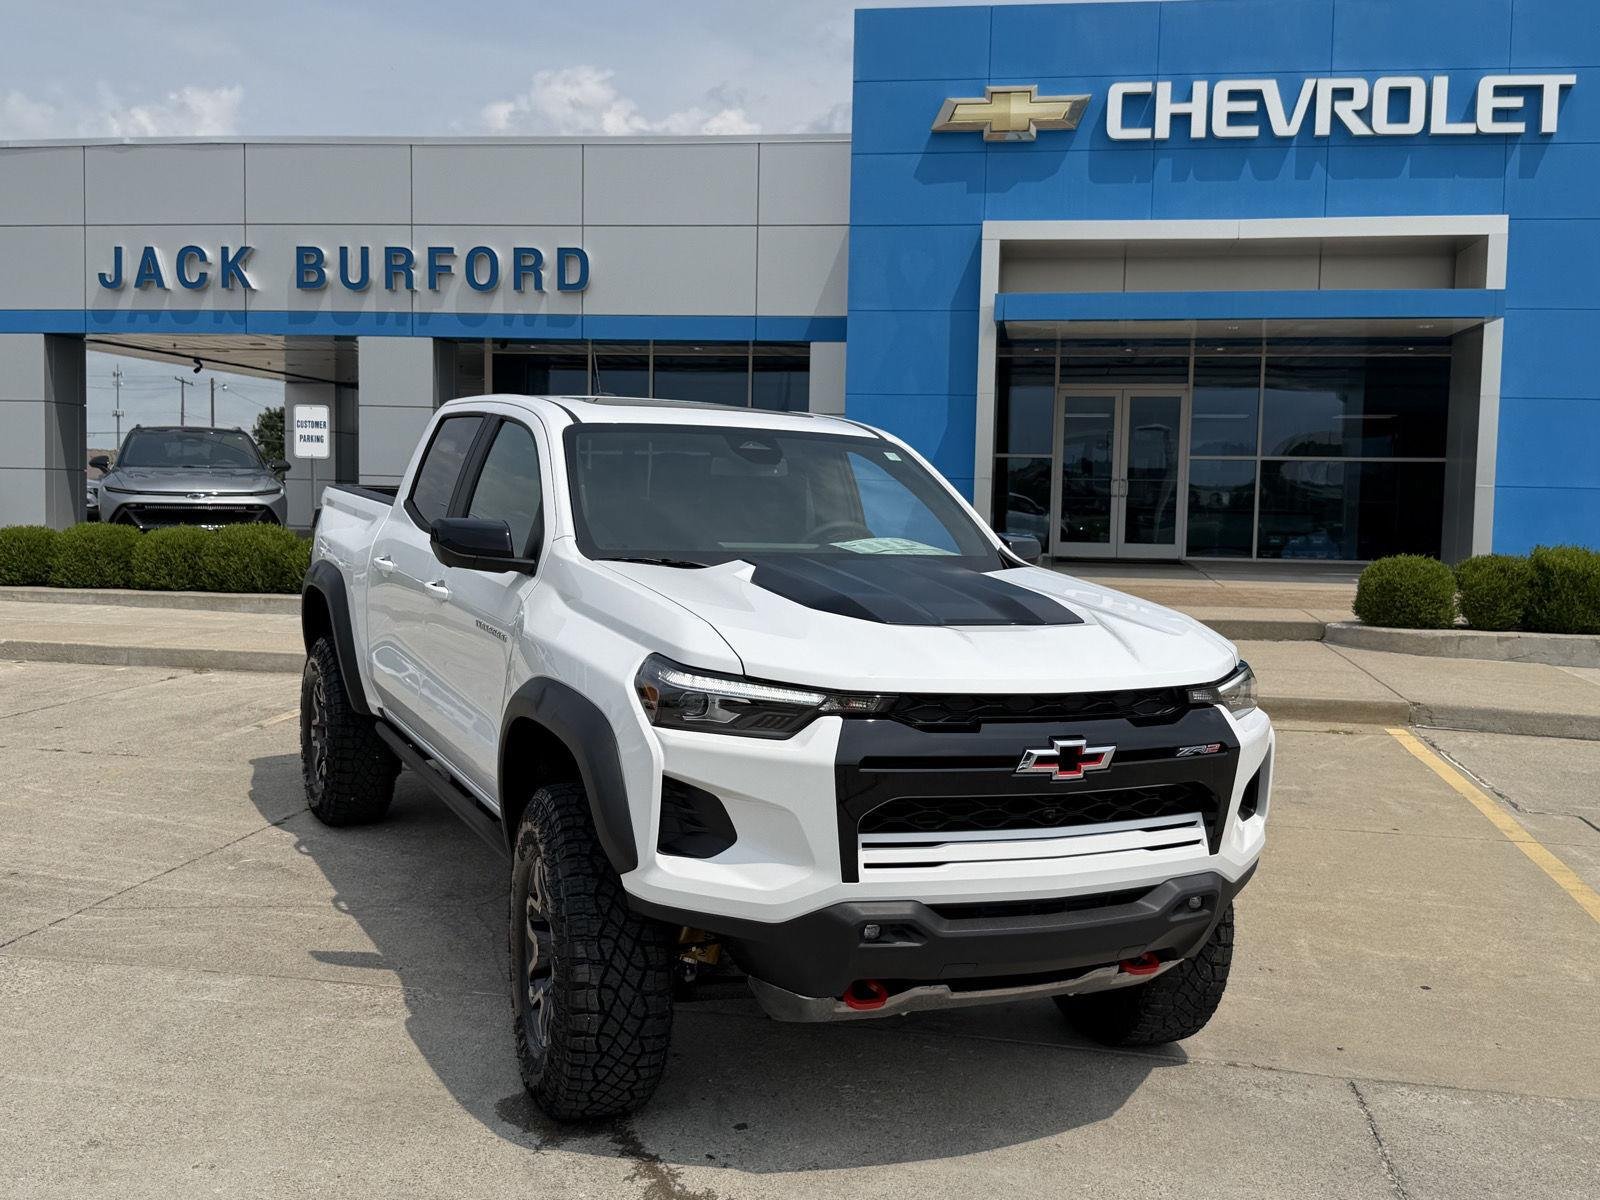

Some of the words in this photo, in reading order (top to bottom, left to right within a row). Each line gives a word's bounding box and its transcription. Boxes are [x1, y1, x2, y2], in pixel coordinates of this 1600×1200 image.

[1106, 74, 1577, 141] CHEVROLET
[98, 245, 254, 290] JACK
[296, 246, 590, 293] BURFORD
[296, 420, 327, 429] CUSTOMER
[299, 434, 325, 443] PARKING
[1176, 744, 1220, 757] ZR2
